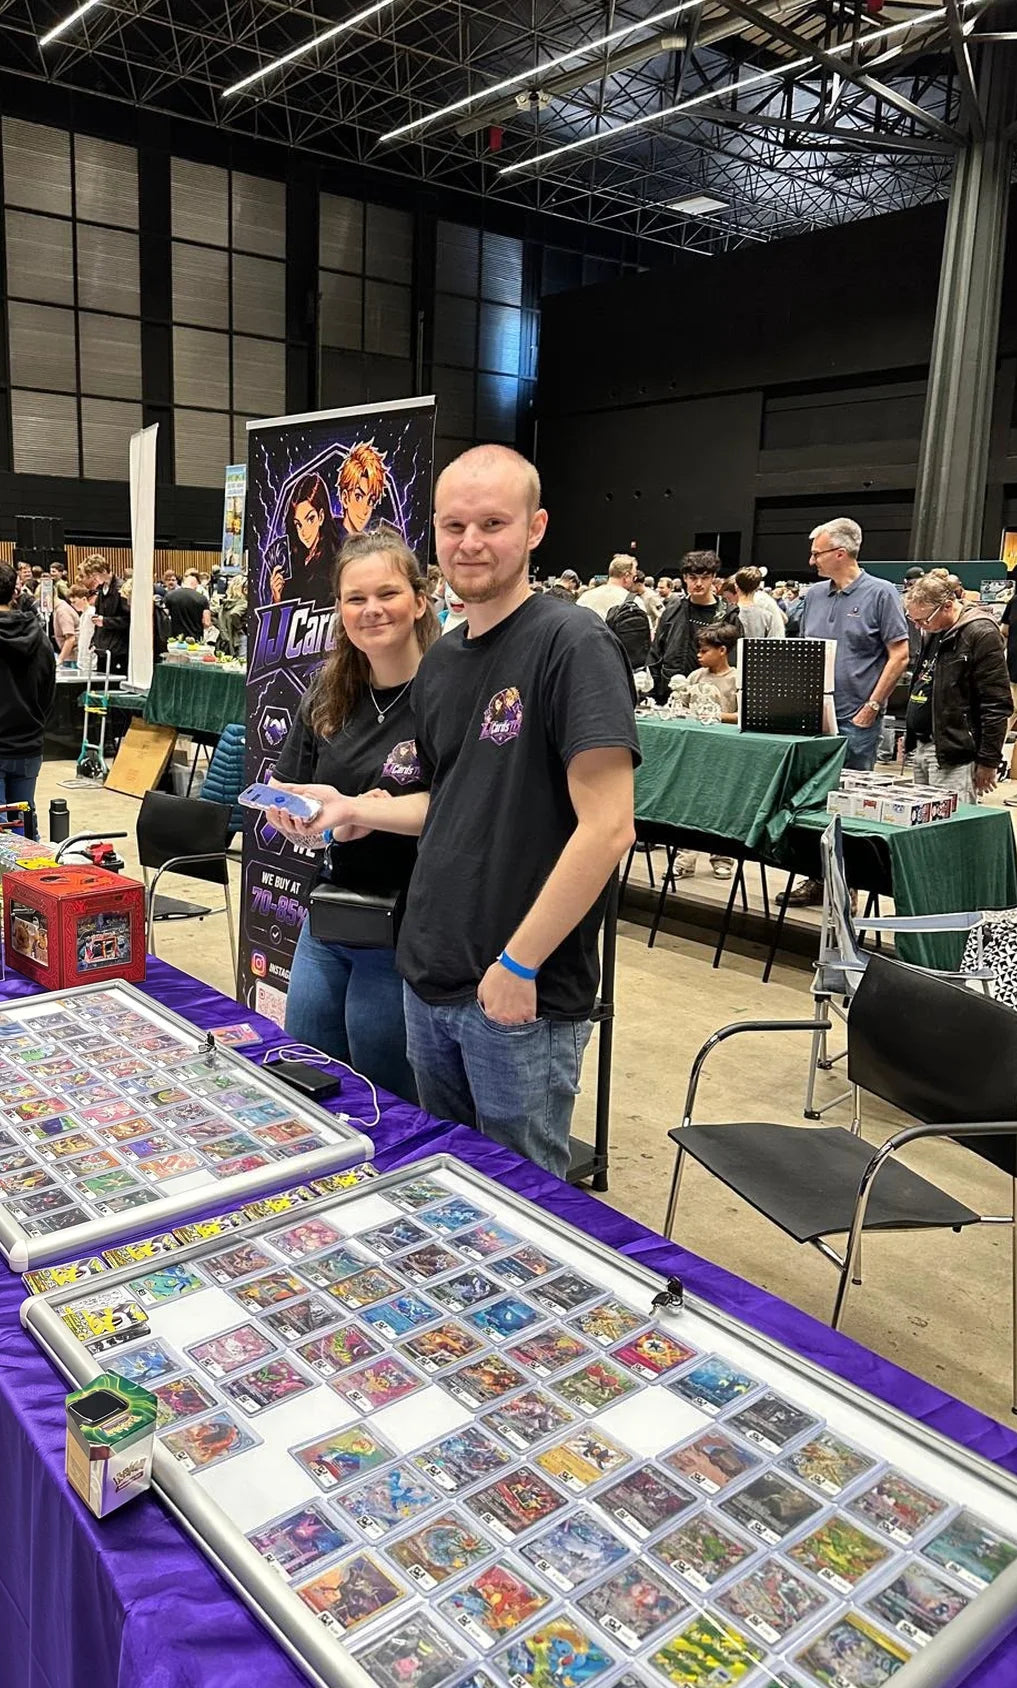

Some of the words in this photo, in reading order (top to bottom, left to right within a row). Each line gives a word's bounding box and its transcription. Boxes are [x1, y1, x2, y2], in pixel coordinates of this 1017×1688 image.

[261, 871, 274, 886] WE
[274, 876, 291, 891] BUY
[290, 882, 302, 895] AT
